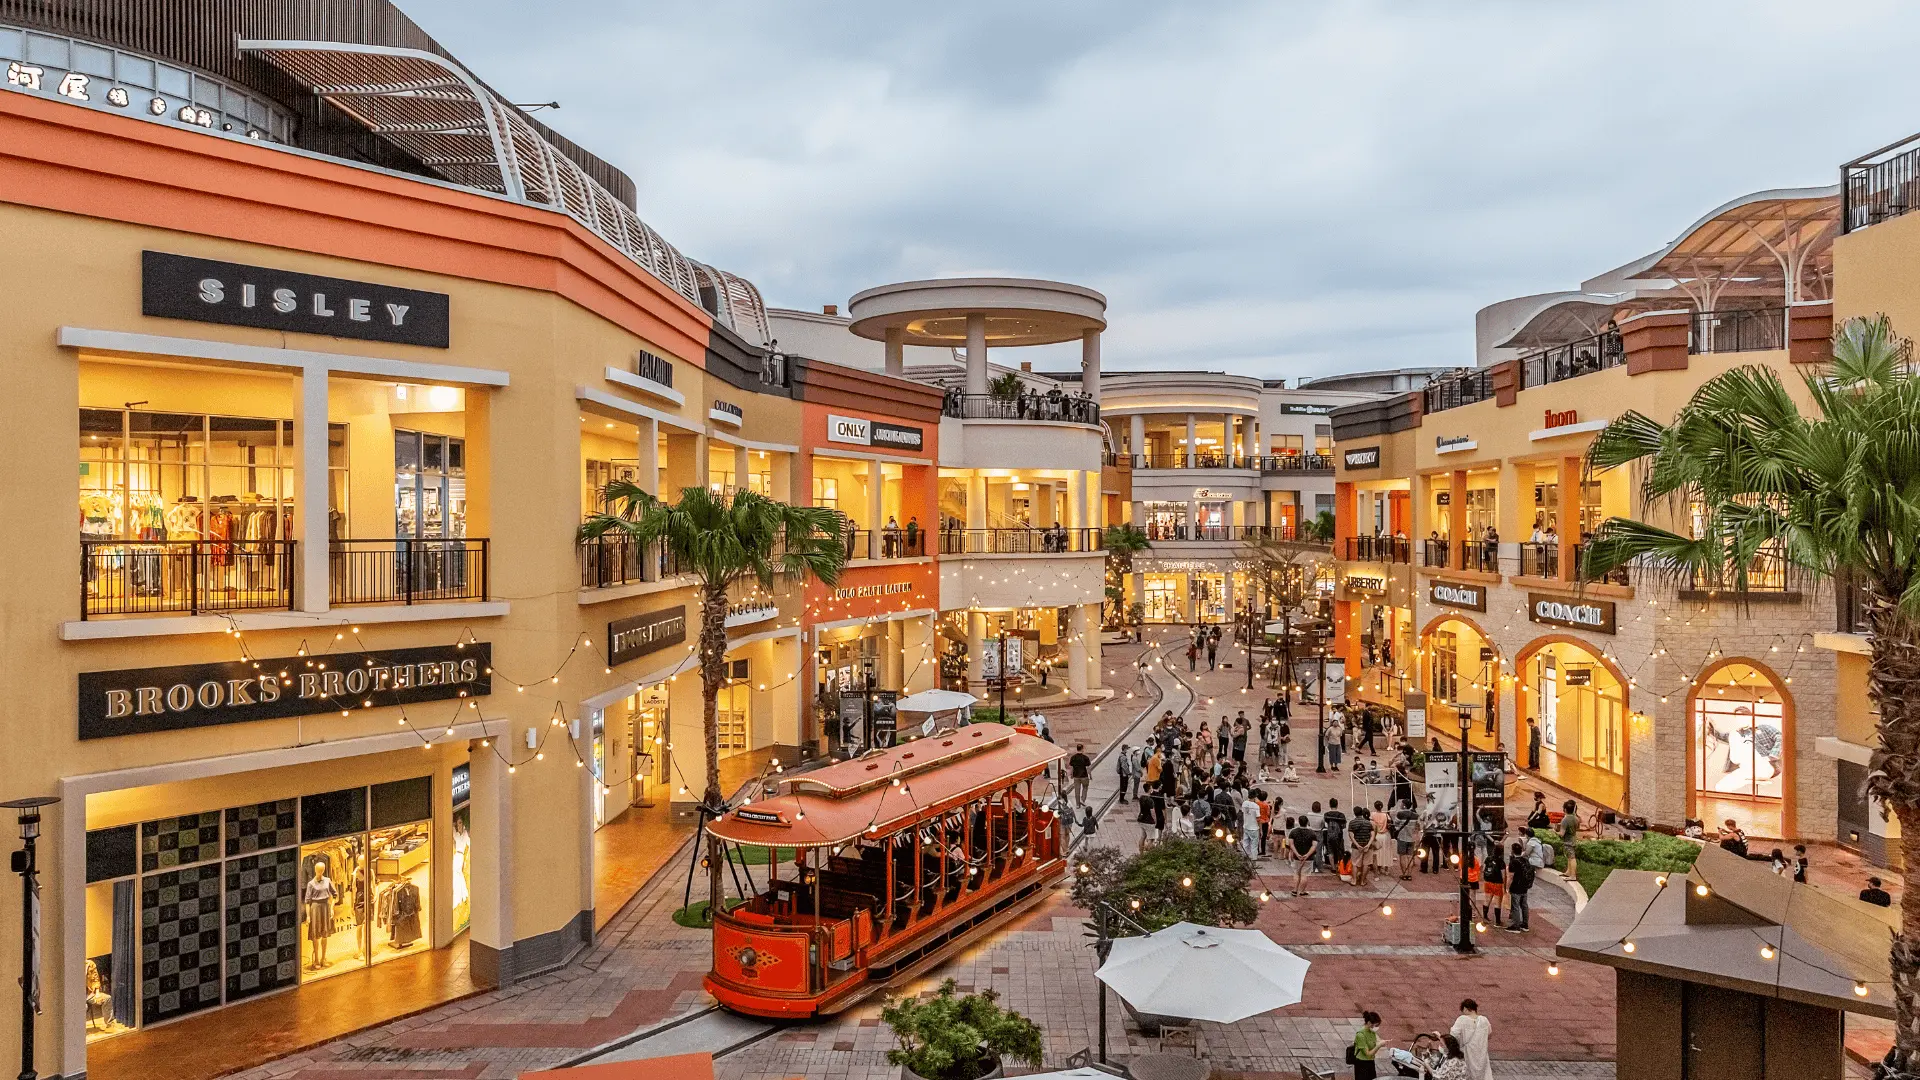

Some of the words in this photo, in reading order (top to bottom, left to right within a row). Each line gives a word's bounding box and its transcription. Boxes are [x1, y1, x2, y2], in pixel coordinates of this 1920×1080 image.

[200, 278, 409, 326] SISLEY
[1544, 409, 1577, 429] iloom
[837, 422, 866, 438] ONLY
[1436, 435, 1469, 450] Champion
[835, 588, 856, 599] POLO
[858, 585, 883, 597] RALPH
[885, 582, 912, 594] LAUREN
[1346, 576, 1383, 589] URBERRY
[1434, 586, 1477, 606] COACH
[727, 601, 775, 618] NGCHAMP
[1536, 601, 1602, 626] COACH
[105, 676, 281, 718] BROOKS
[299, 659, 477, 699] BROTHERS
